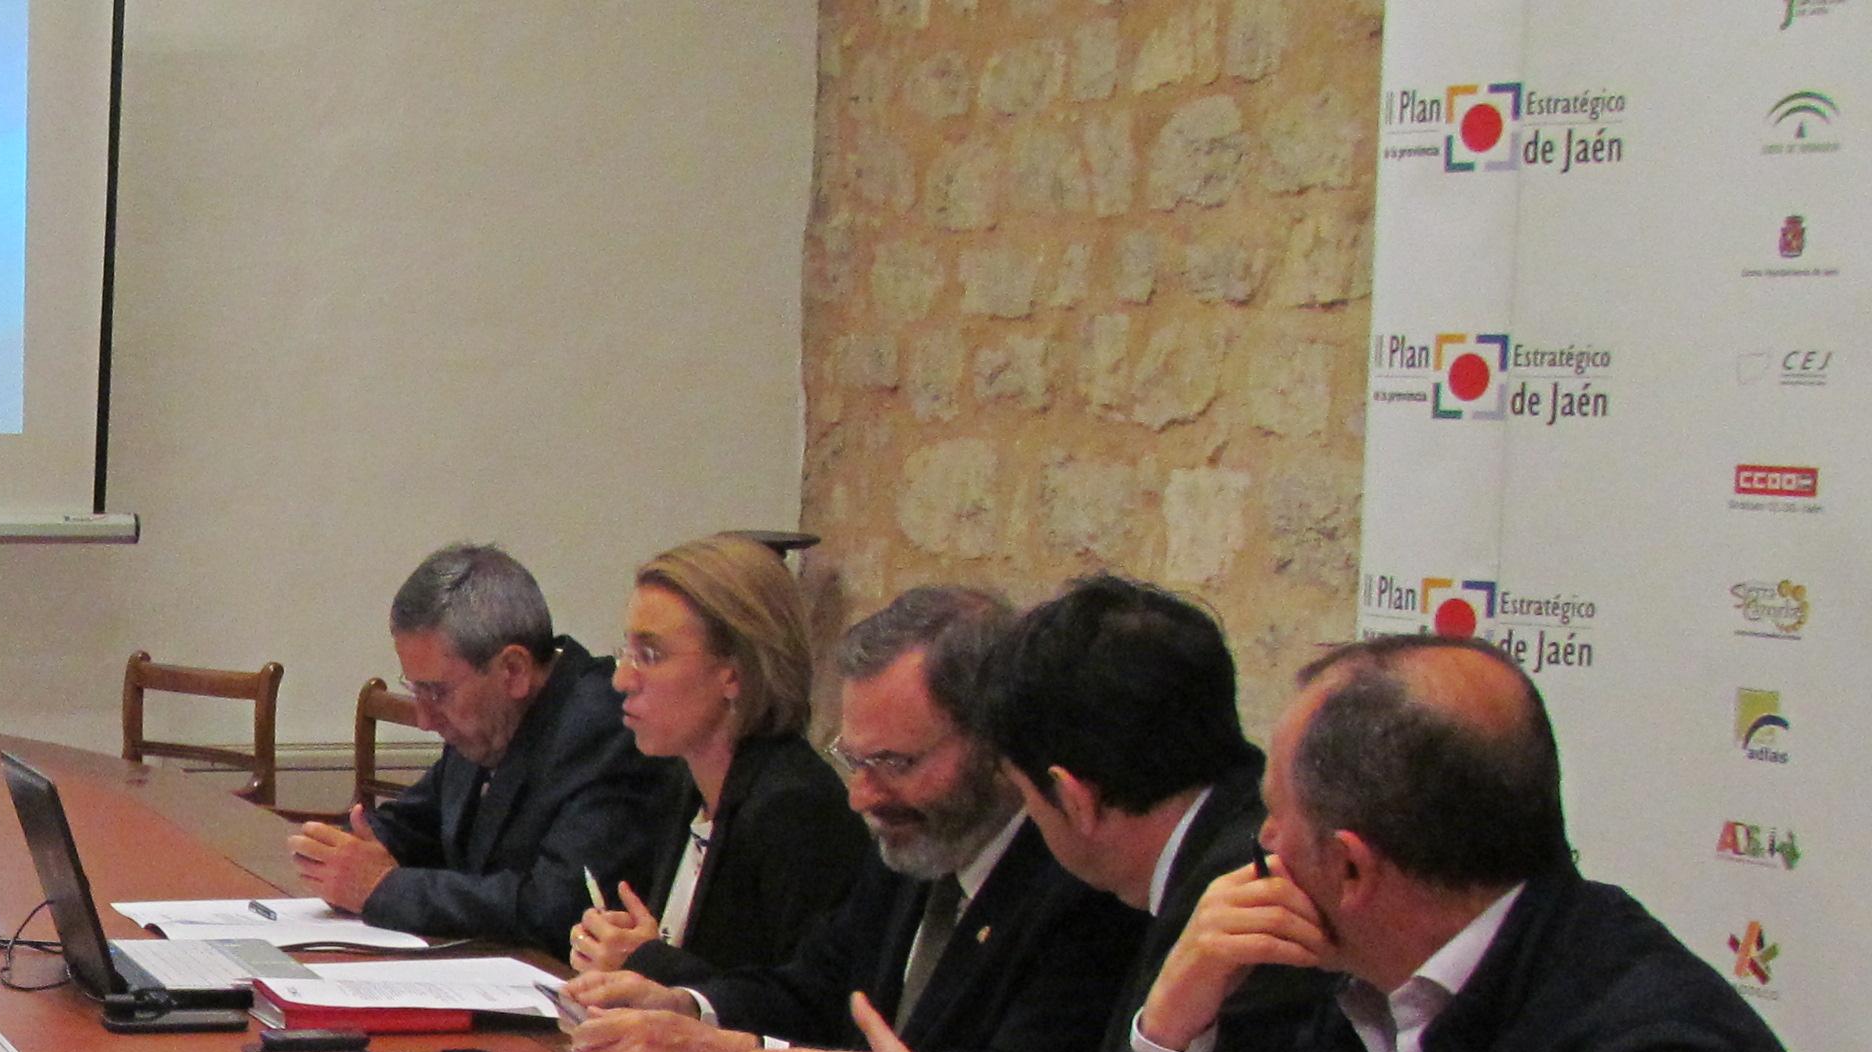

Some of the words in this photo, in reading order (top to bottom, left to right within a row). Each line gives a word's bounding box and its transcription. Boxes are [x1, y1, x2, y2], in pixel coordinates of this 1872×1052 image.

[1400, 90, 1440, 124] Plan
[1525, 88, 1625, 120] Estratégico
[1523, 129, 1554, 164] de
[1560, 128, 1622, 173] Jaén
[1389, 335, 1429, 368] Plan
[1513, 345, 1611, 375] Estratégico
[1512, 382, 1540, 416] de
[1546, 381, 1608, 425] Jaén
[1740, 471, 1796, 491] CCOO
[1377, 576, 1416, 611] Plan
[1500, 592, 1596, 624] Estratégico
[1500, 629, 1526, 663] de
[1533, 630, 1592, 673] Jaén
